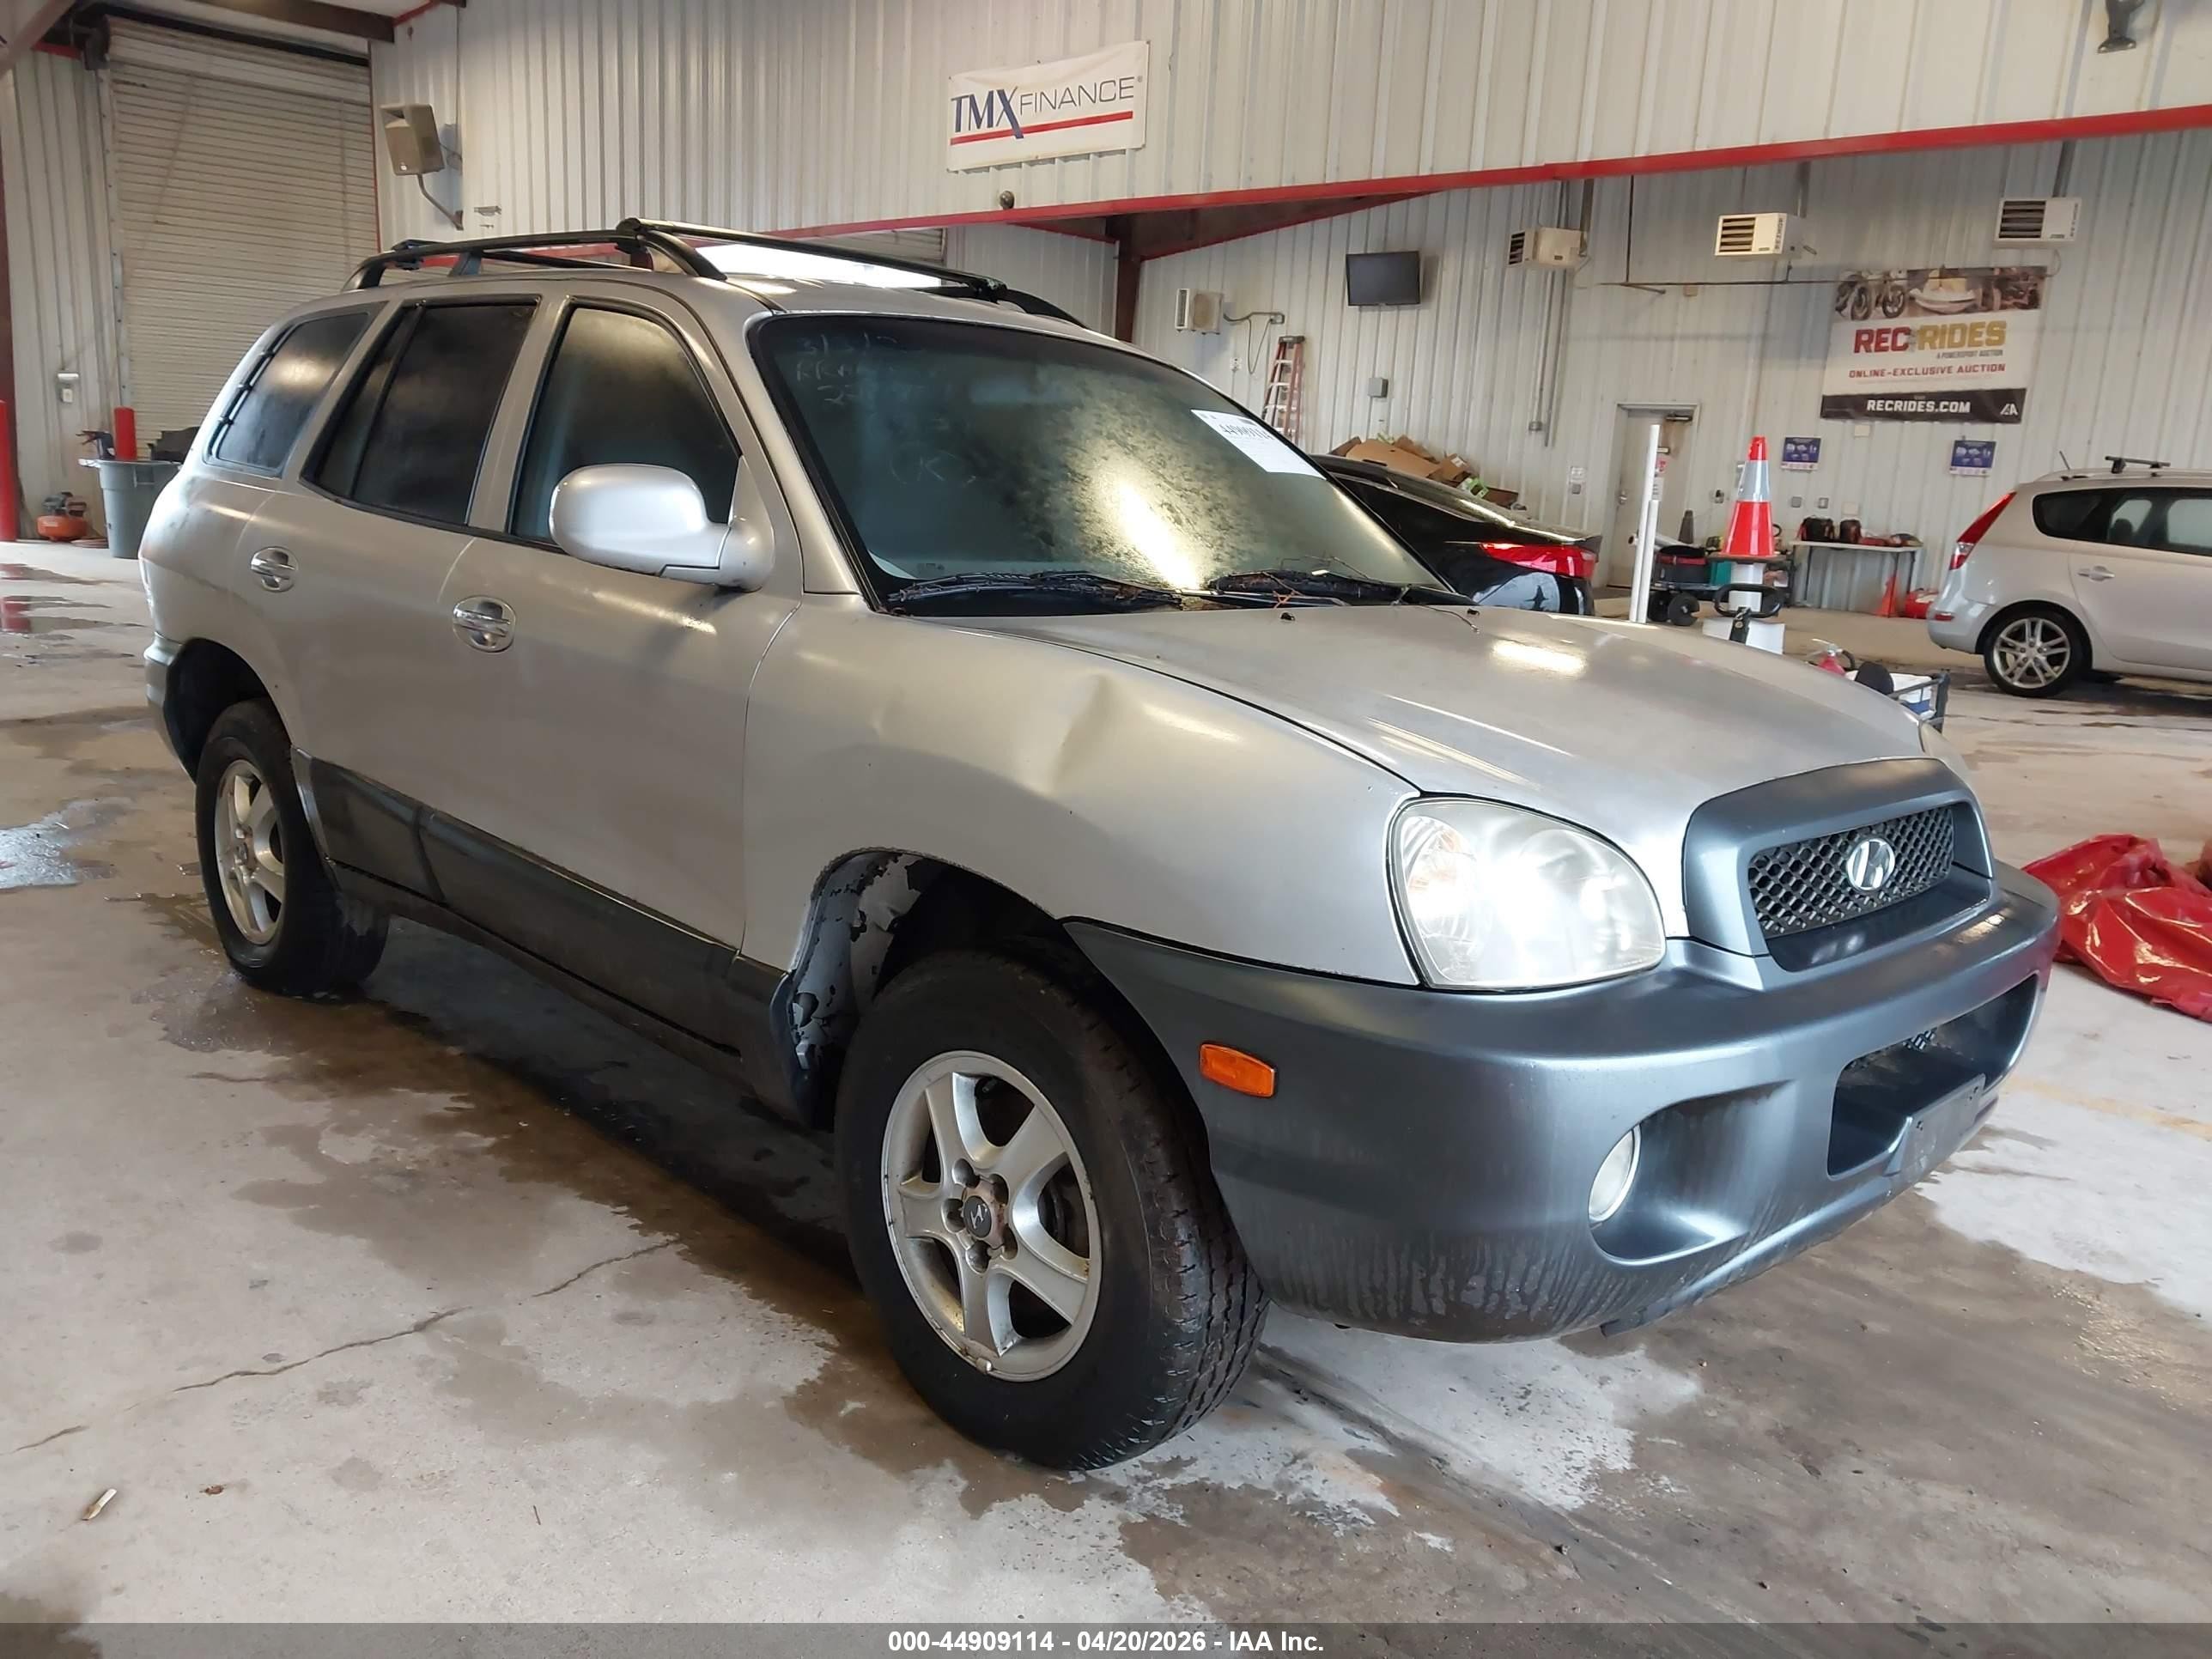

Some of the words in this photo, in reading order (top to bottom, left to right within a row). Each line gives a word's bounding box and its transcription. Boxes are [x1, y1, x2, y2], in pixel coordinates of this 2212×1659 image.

[951, 86, 1024, 139] TMX
[1019, 76, 1134, 115] FINANCE
[1917, 320, 2007, 350] RIDES
[1849, 366, 1954, 379] ONLINE-EXCLUSIVE
[1957, 363, 2006, 374] AUCTION
[1867, 399, 1971, 413] RECRIDES.COM
